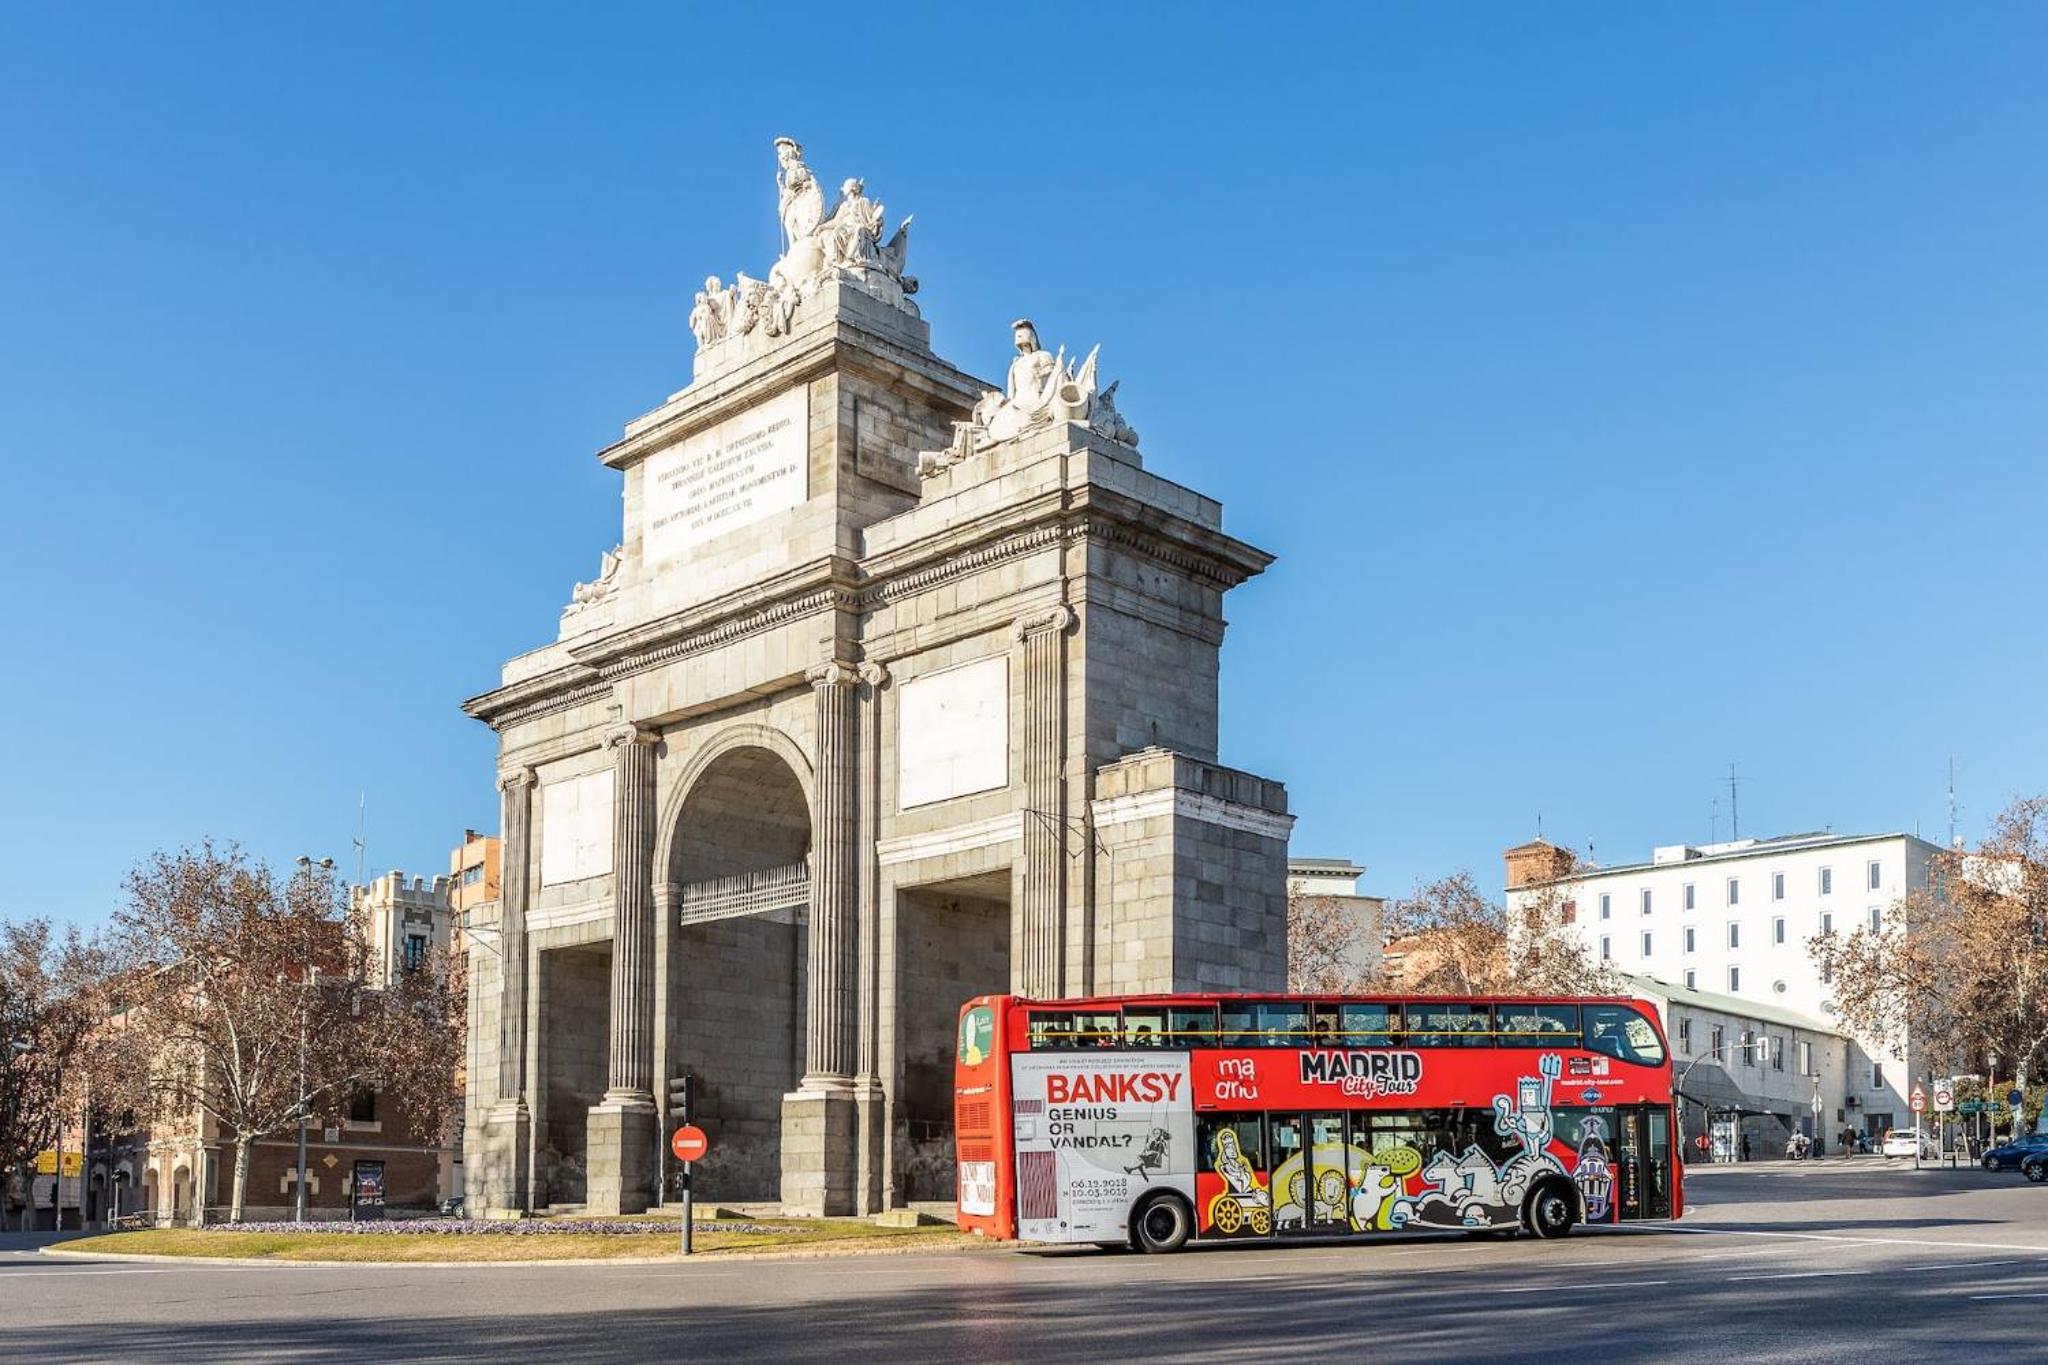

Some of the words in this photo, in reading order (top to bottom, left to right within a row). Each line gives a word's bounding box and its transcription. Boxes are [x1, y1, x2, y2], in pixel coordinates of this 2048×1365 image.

[1301, 1052, 1421, 1083] MADRID
[1047, 1073, 1182, 1104] BANKSY
[1342, 1076, 1376, 1099] City
[1376, 1075, 1416, 1095] Tour
[1049, 1108, 1117, 1121] GENIUS
[1049, 1122, 1074, 1135] OR
[1049, 1134, 1132, 1149] VANDAL?
[1071, 1178, 1127, 1187] 06.12.2018
[1072, 1188, 1127, 1197] 10.03.2019
